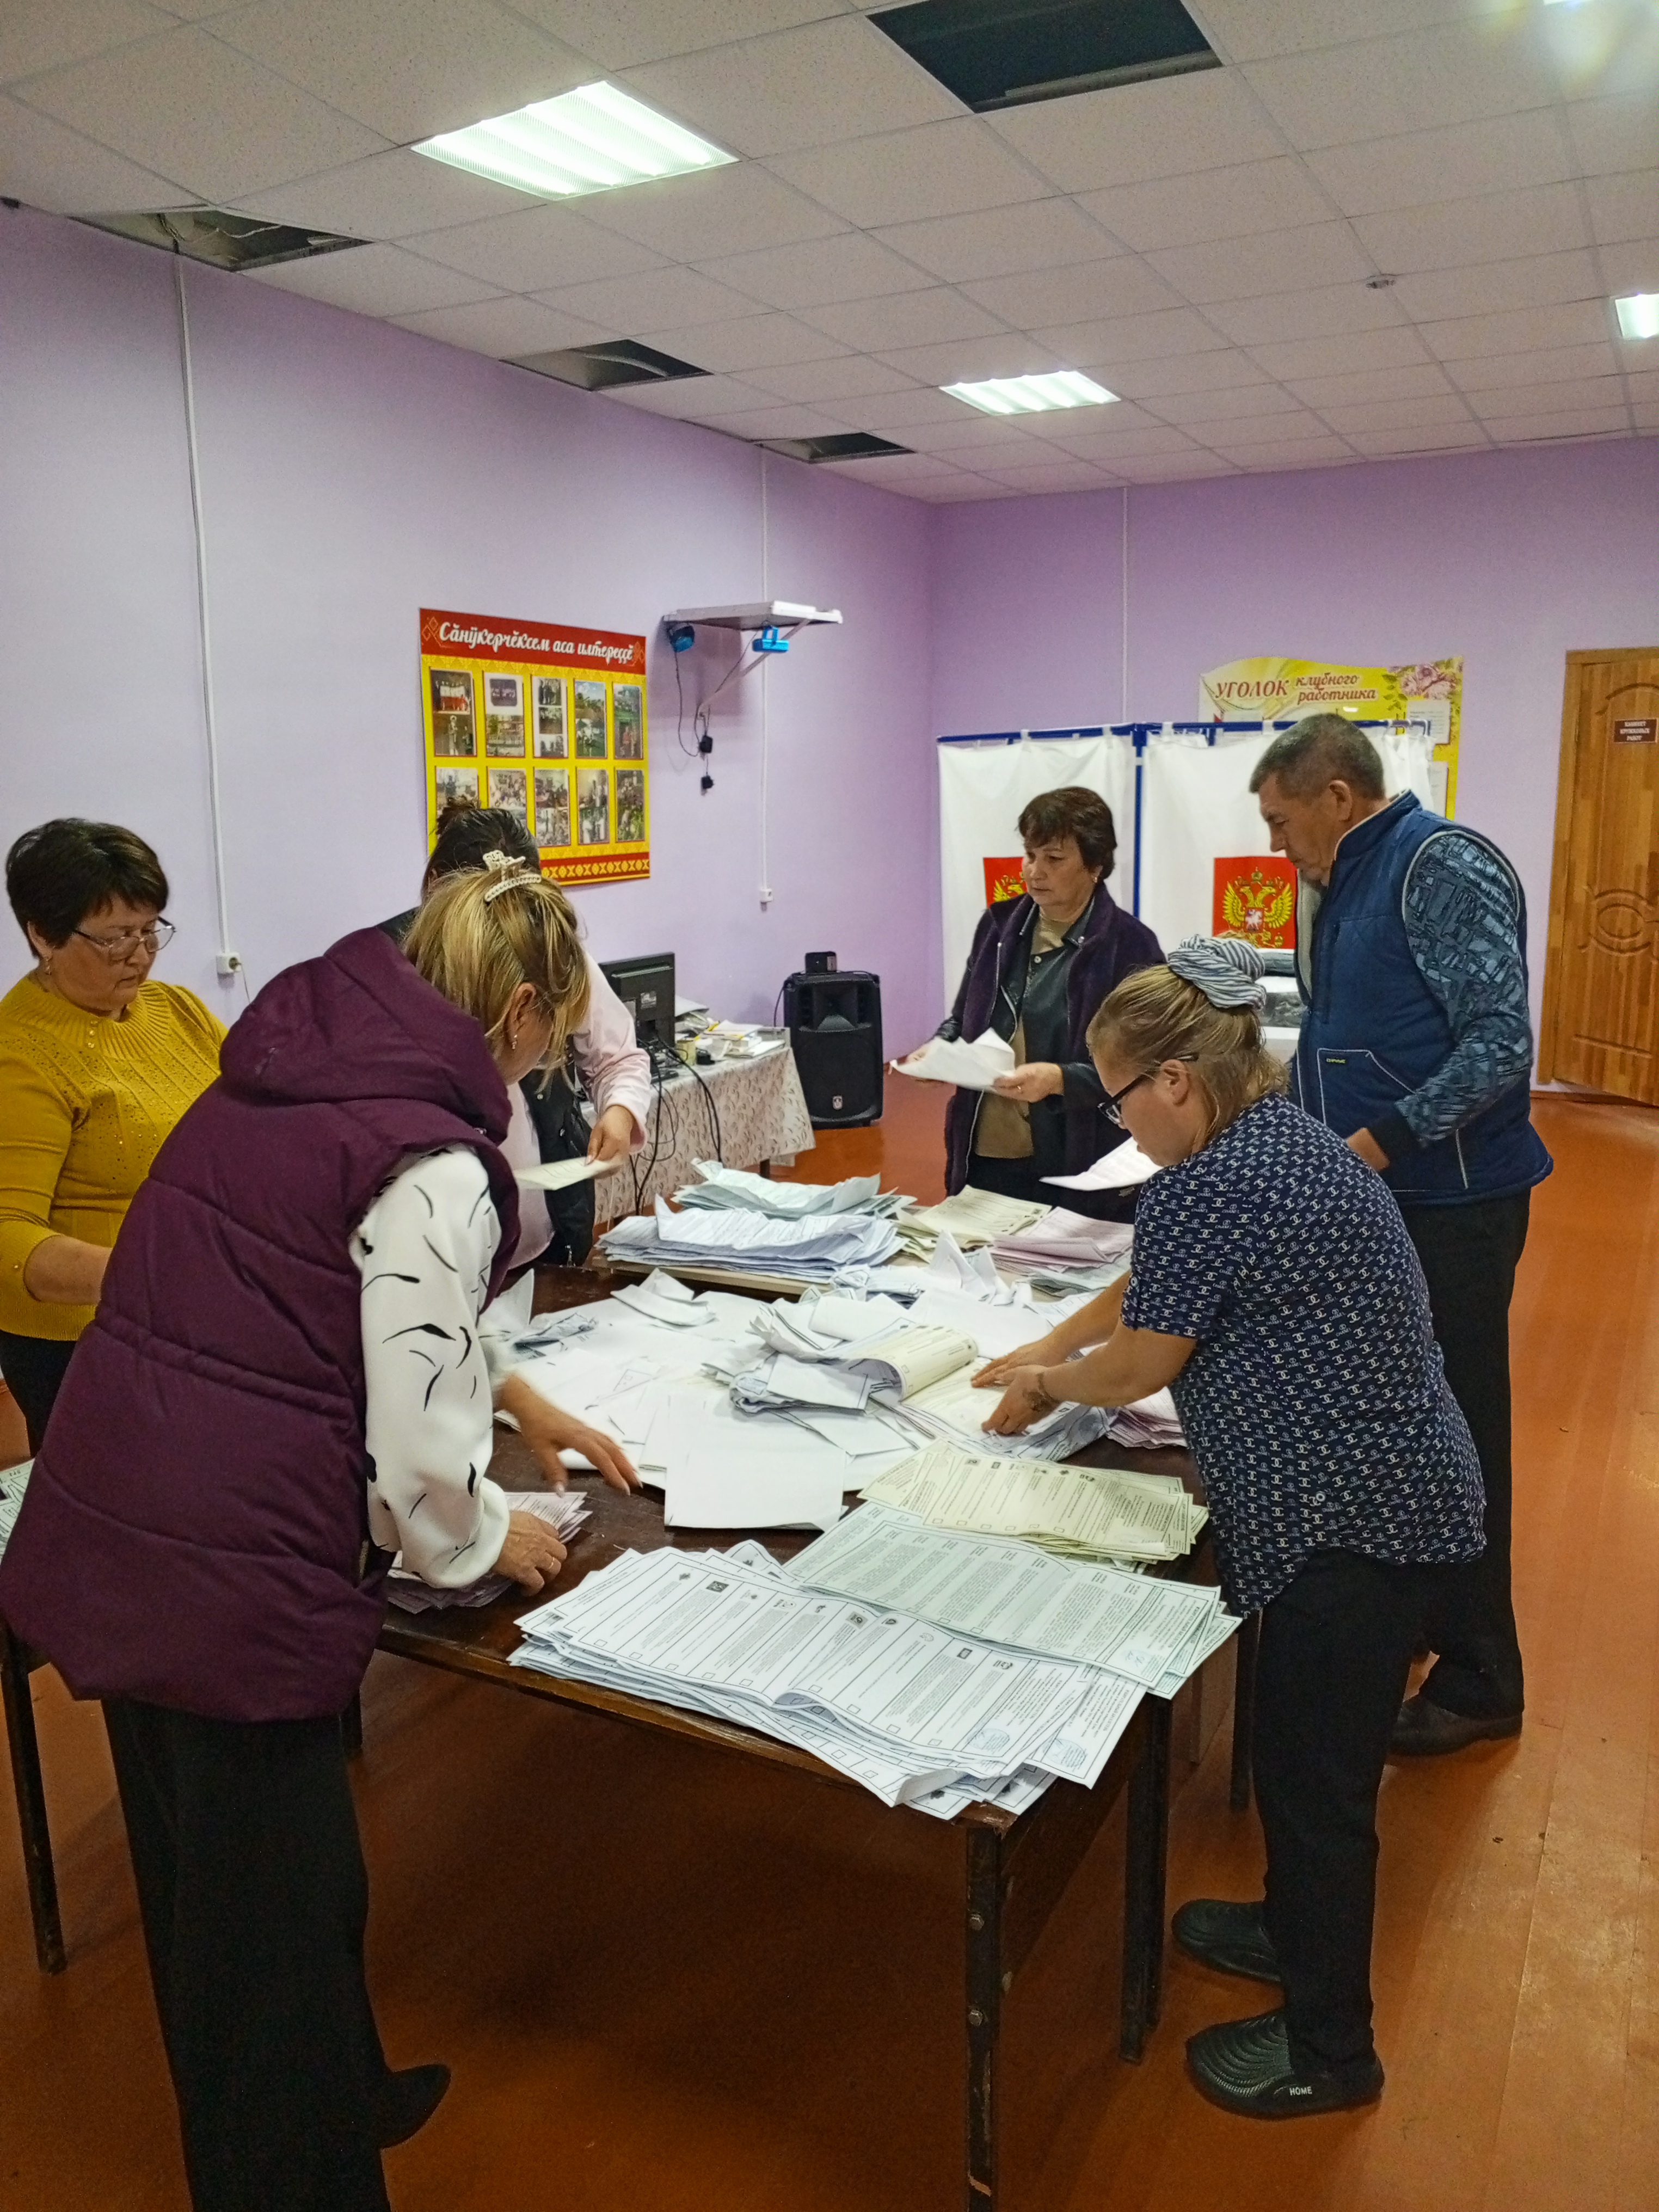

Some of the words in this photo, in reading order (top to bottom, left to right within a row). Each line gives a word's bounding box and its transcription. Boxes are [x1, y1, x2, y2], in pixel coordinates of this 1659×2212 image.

[552, 641, 575, 654] аса
[1215, 680, 1289, 698] УГОЛОК
[1295, 672, 1360, 690] клубного
[1297, 687, 1376, 705] работника
[1289, 2086, 1313, 2096] HOME
